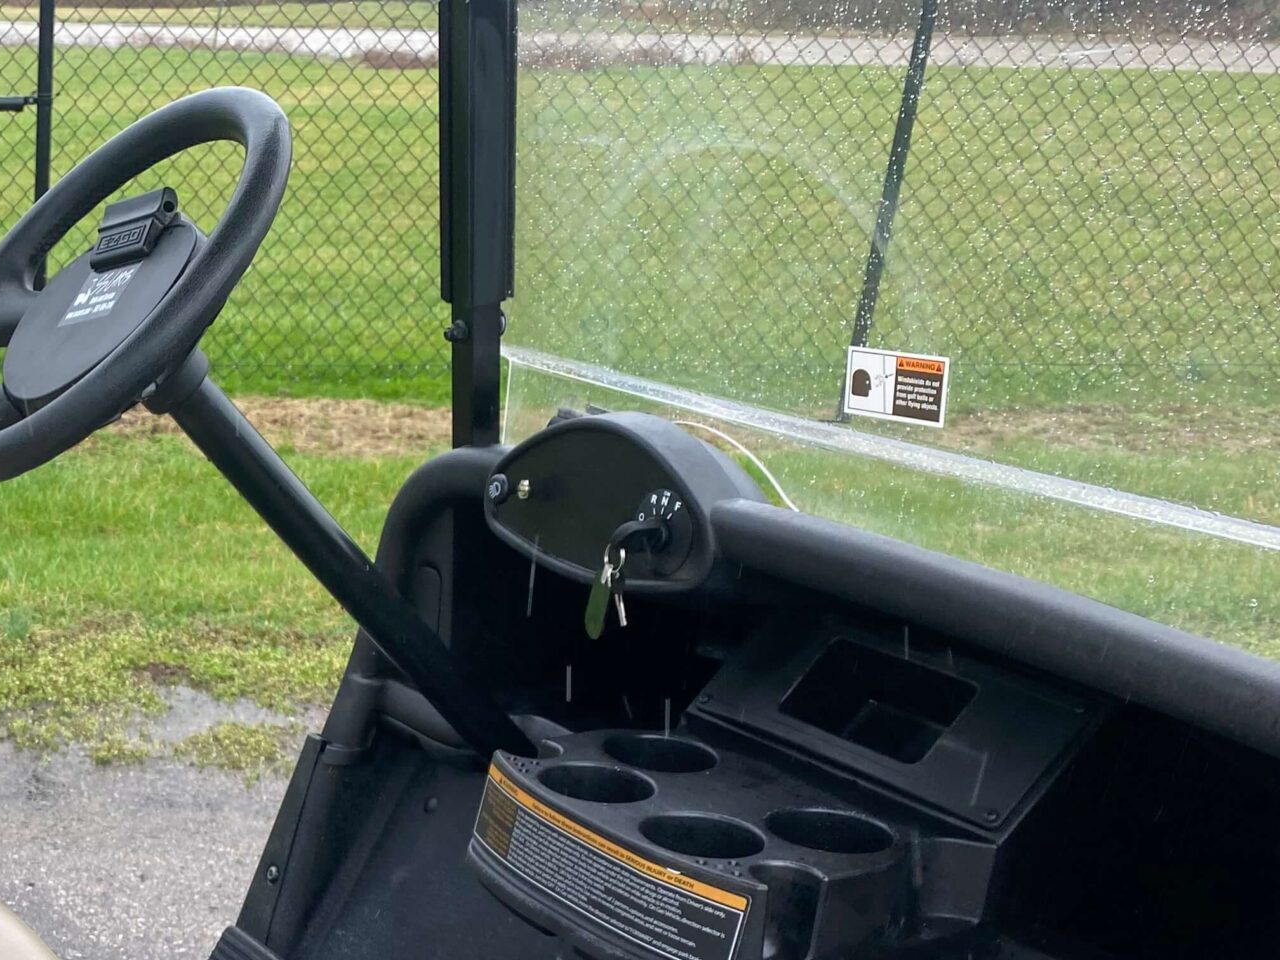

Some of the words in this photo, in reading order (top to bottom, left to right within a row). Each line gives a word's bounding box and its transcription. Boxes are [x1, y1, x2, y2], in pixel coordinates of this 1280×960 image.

[906, 361, 935, 370] WARNING
[908, 400, 920, 409] flying
[650, 494, 657, 504] R
[661, 495, 669, 506] N
[674, 501, 682, 511] F
[625, 854, 646, 868] SERIOUS
[646, 864, 666, 878] INJURY
[673, 876, 694, 888] DEATH
